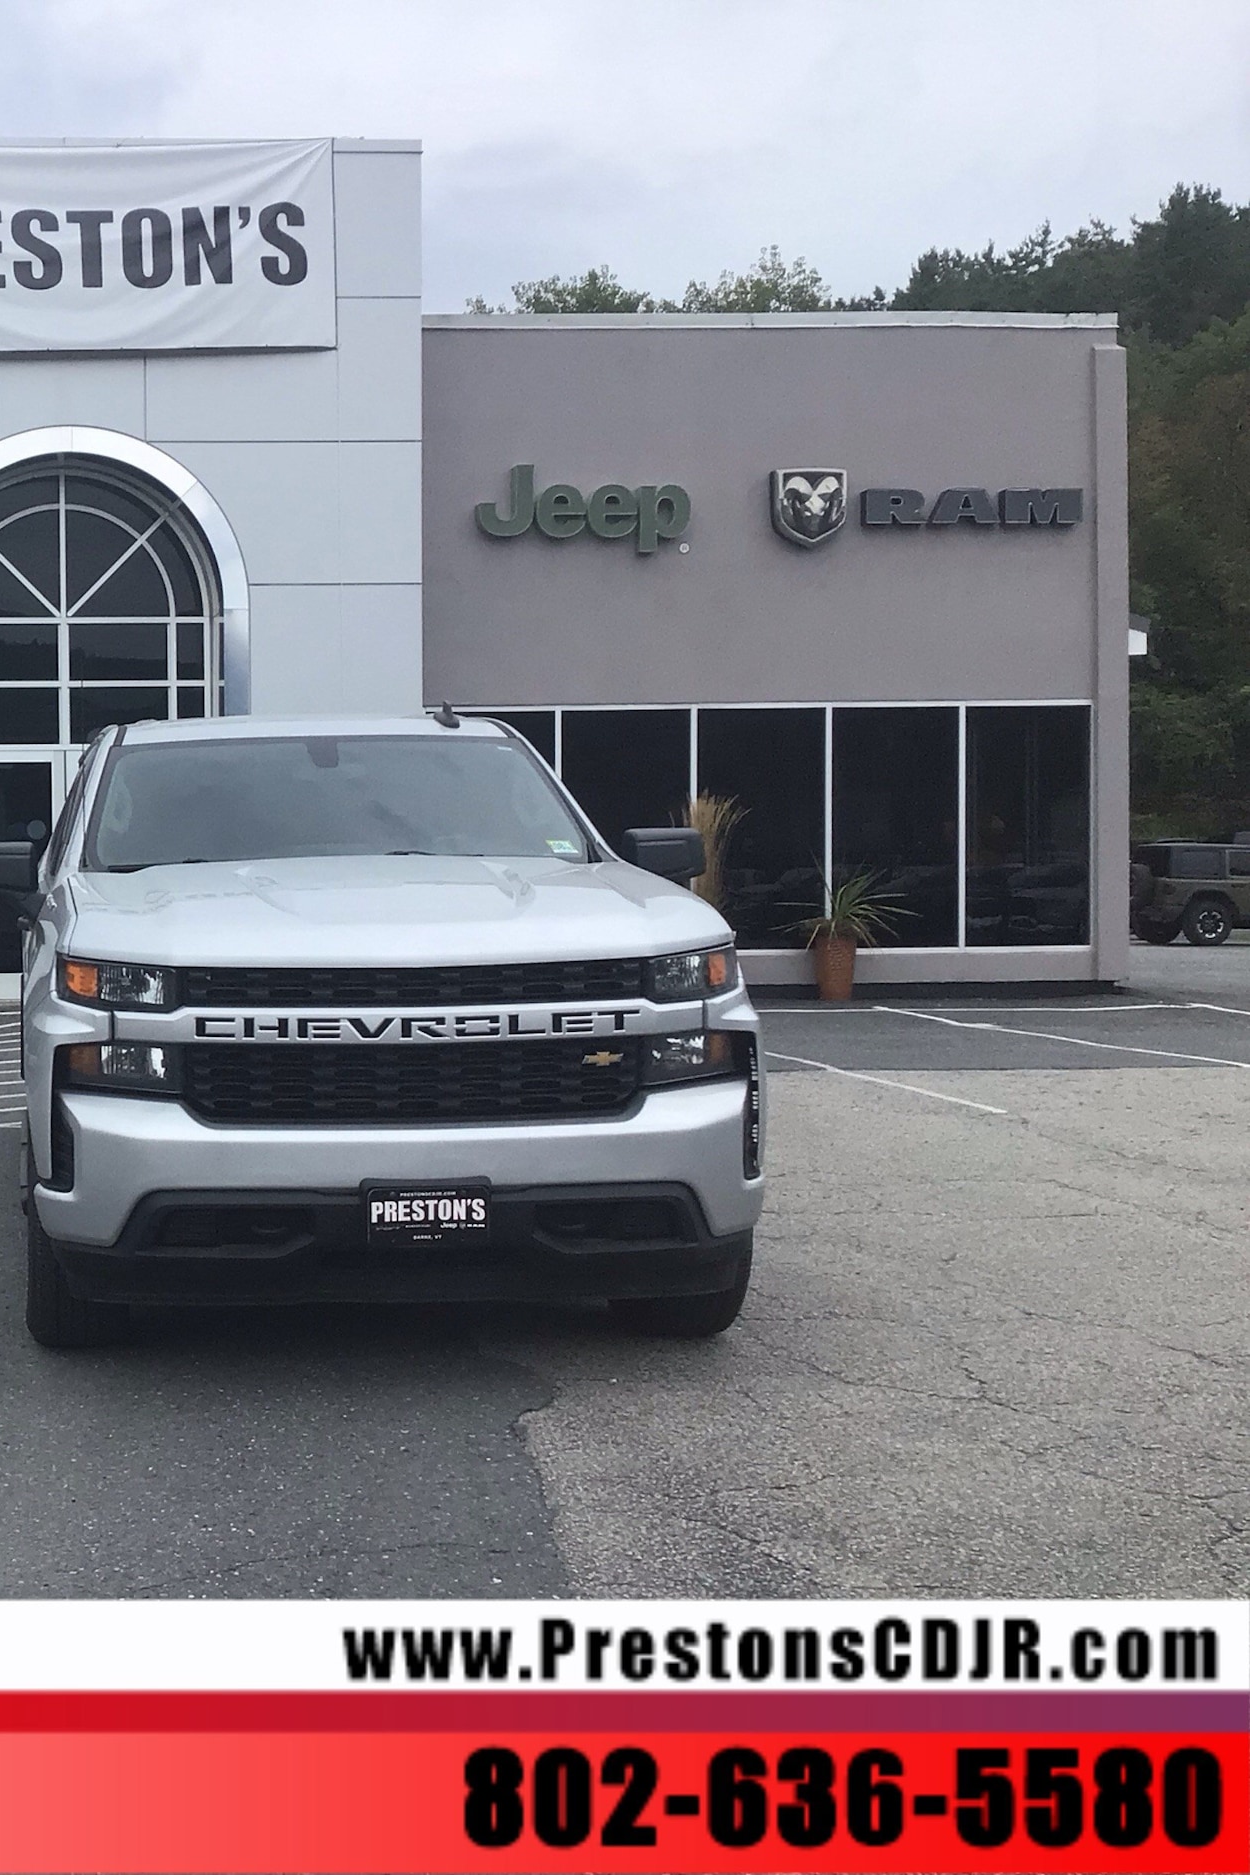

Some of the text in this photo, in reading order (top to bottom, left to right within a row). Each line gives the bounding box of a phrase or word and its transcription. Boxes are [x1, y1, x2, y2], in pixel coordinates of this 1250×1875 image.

[477, 464, 691, 554] Jeep
[860, 487, 1083, 527] RAM
[194, 1009, 640, 1040] CHEVROLET
[371, 1198, 486, 1224] PRESTON'S
